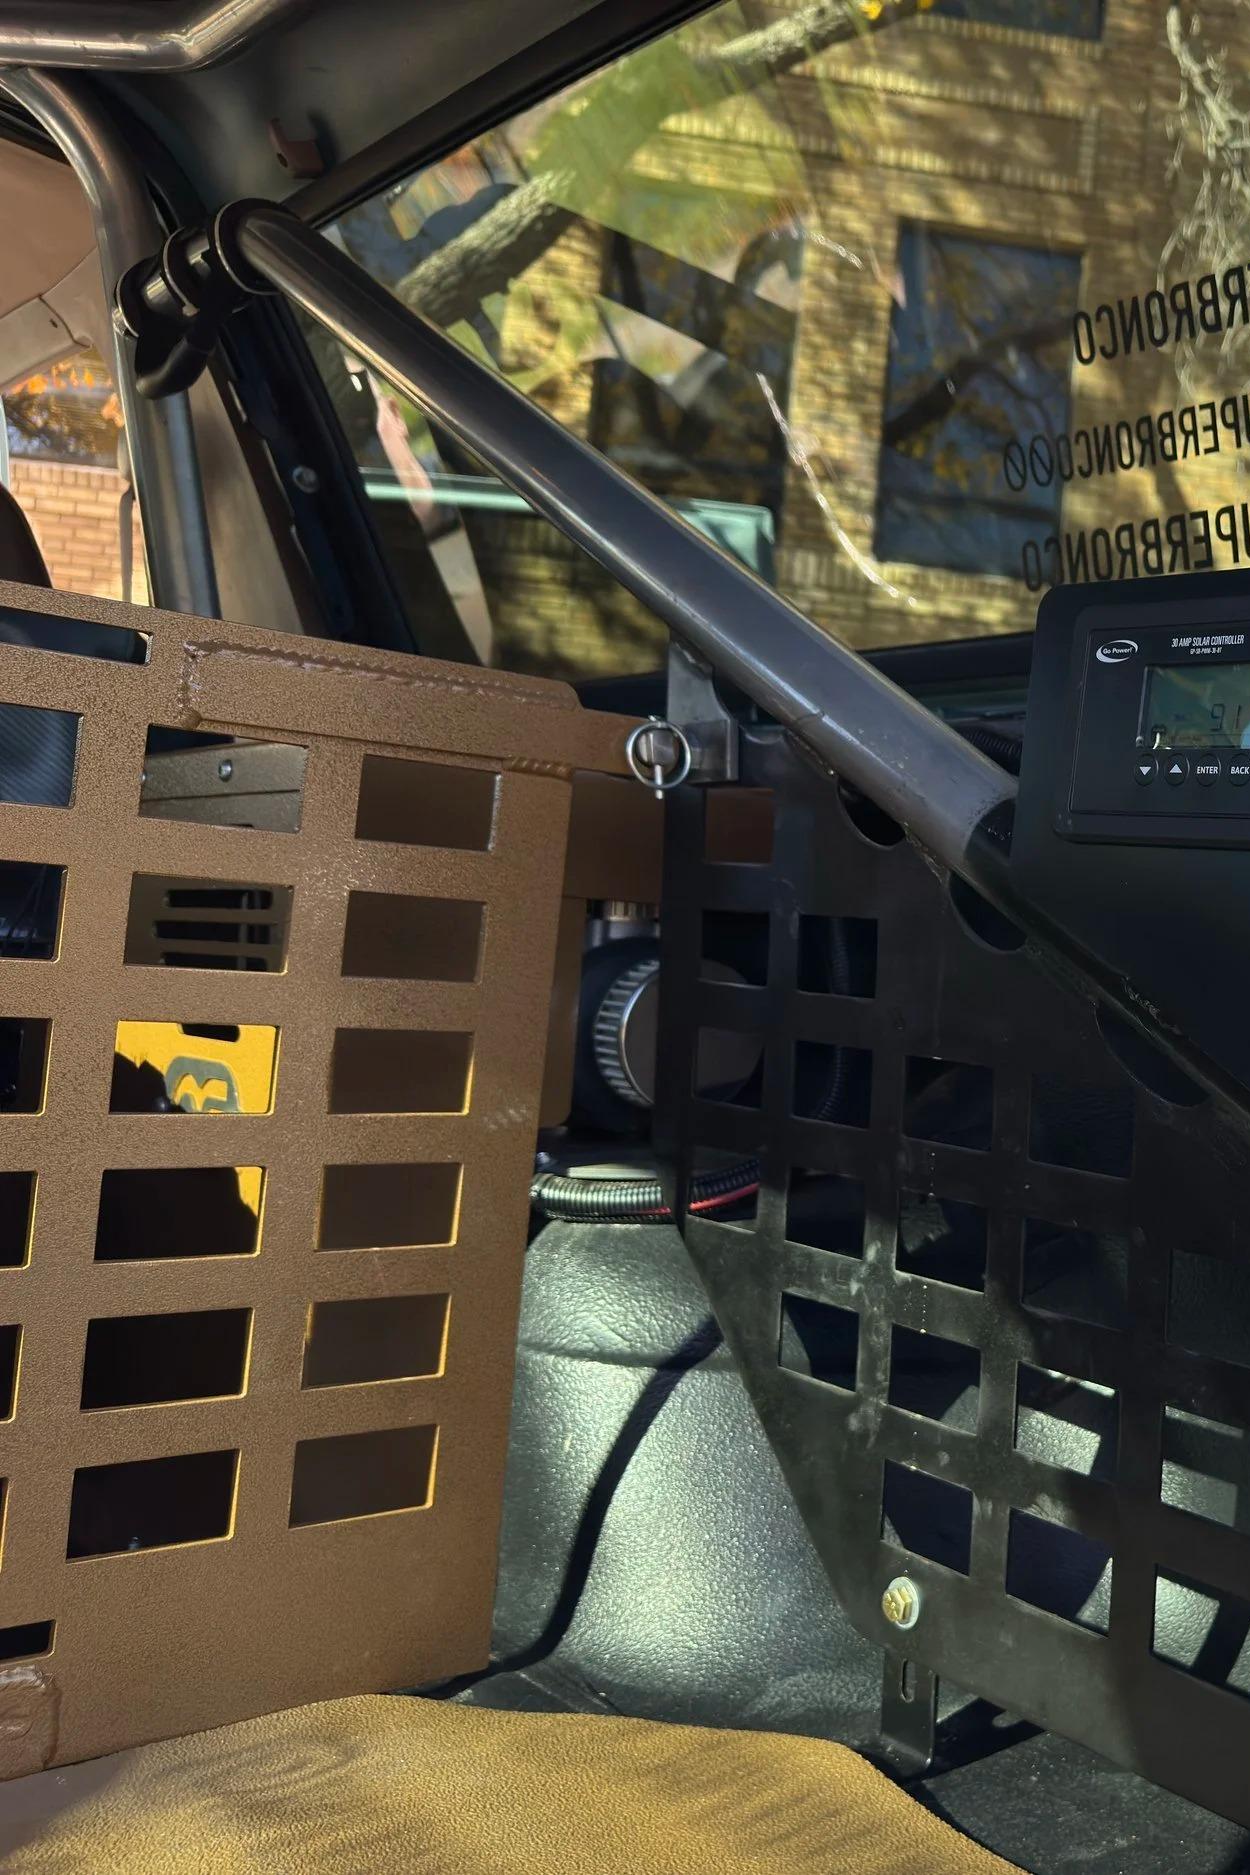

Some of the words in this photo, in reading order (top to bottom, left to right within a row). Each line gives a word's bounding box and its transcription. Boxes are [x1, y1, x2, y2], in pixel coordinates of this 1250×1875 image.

[1171, 638, 1179, 648] 30
[1179, 637, 1192, 647] AMP
[1192, 636, 1211, 647] SOLAR
[1210, 635, 1245, 646] CONTROLLER
[1102, 647, 1112, 655] Go
[1196, 766, 1219, 775] ENTER
[1230, 766, 1250, 775] BACK
